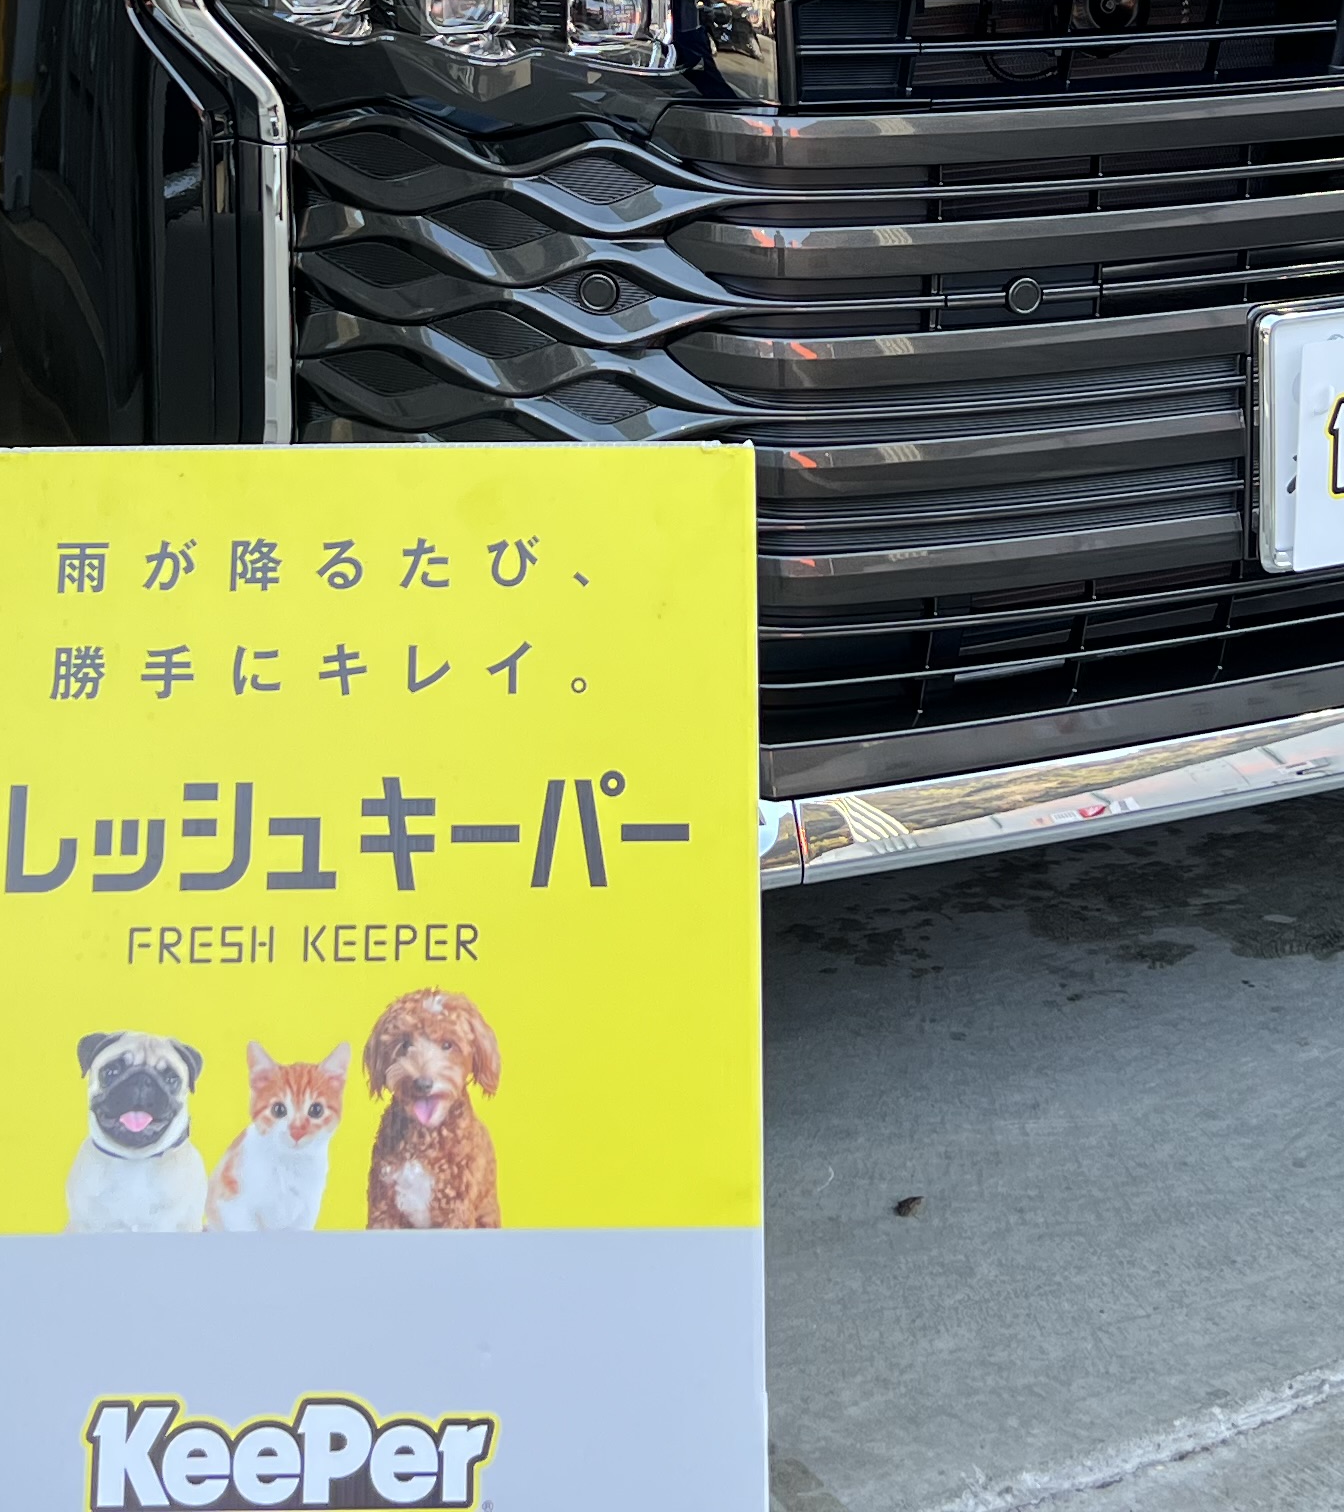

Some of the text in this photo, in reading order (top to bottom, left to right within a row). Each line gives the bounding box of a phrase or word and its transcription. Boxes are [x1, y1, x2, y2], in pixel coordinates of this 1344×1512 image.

[56, 534, 591, 594] 雨が降るたび、
[49, 641, 588, 700] 勝手にキレイ。
[128, 923, 480, 965] FRESH KEEPER
[87, 1397, 494, 1510] KeePer
